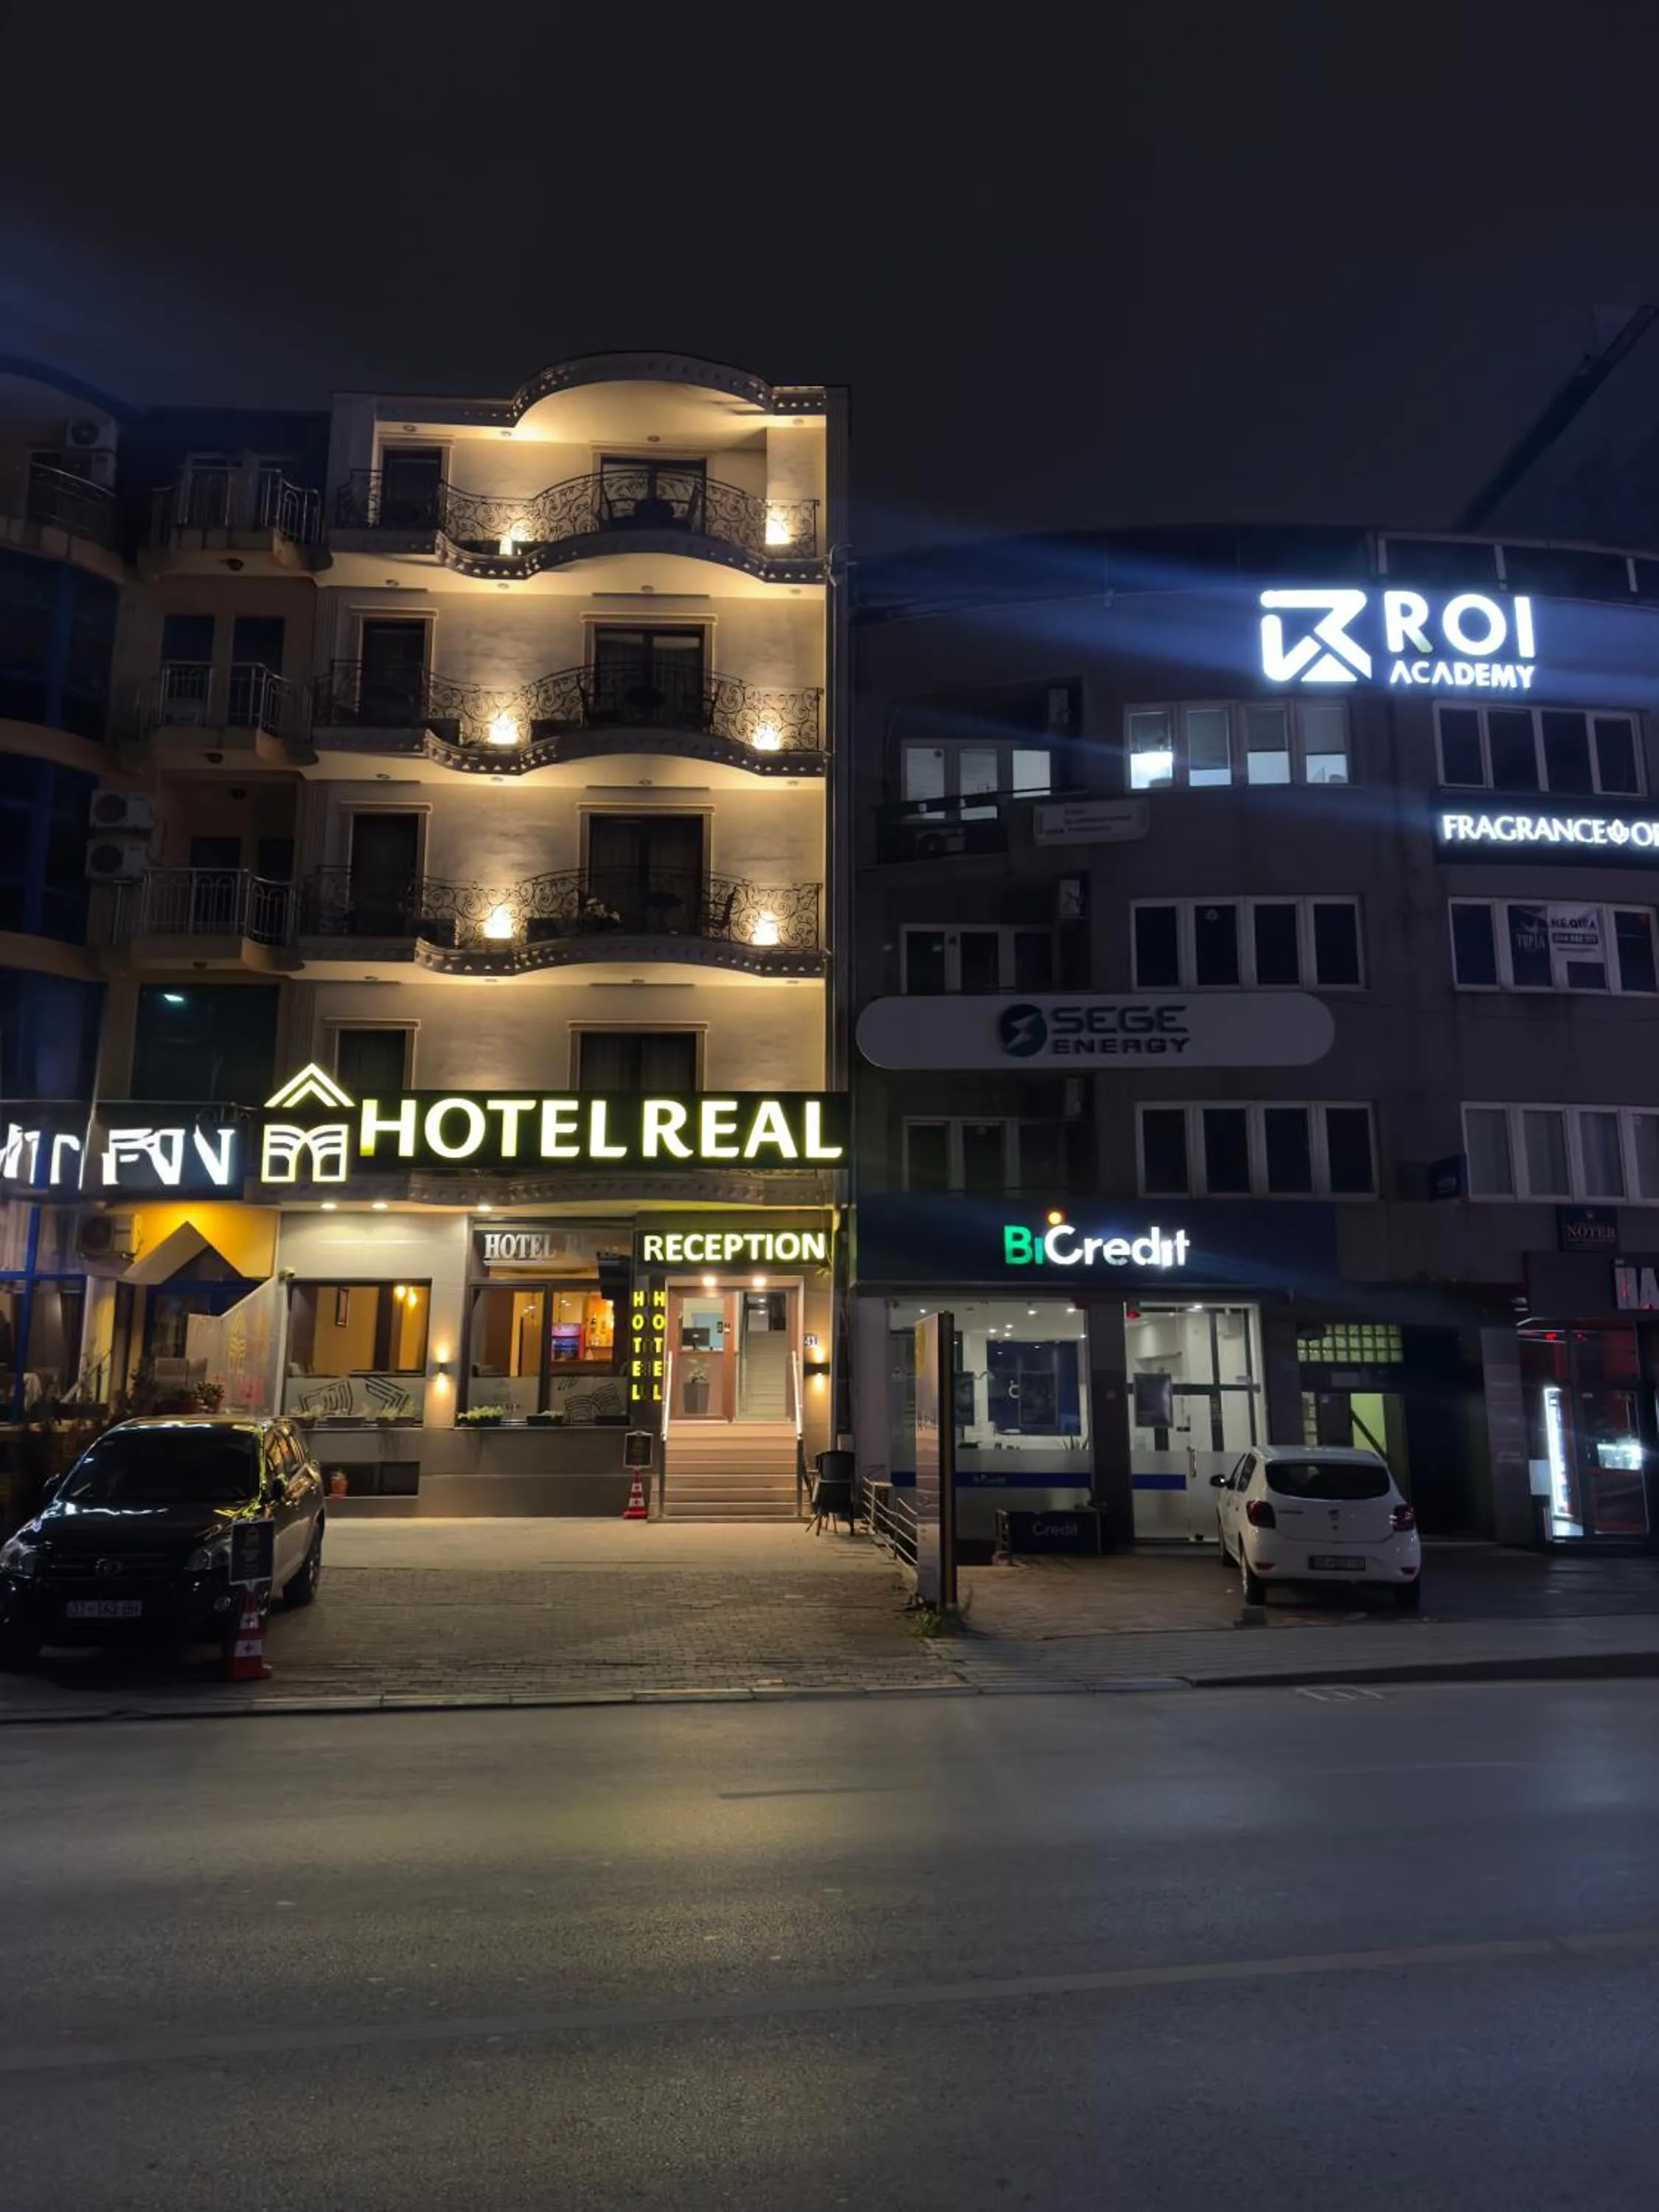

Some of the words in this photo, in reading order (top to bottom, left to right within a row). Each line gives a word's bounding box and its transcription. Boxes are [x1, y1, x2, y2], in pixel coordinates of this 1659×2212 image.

[1383, 591, 1535, 658] ROI
[1390, 660, 1535, 689] ACADEMY
[1441, 814, 1607, 844] FRAGRANCE
[1050, 1005, 1189, 1033] SEGE
[1051, 1038, 1190, 1055] ENERGY
[359, 1098, 627, 1159] HOTEL
[642, 1099, 843, 1159] REAL
[484, 1234, 555, 1259] HOTEL
[644, 1232, 825, 1262] RECEPTION
[1004, 1211, 1190, 1267] BiCredit
[632, 1291, 644, 1400] HOTEL
[653, 1291, 665, 1400] HOTEL
